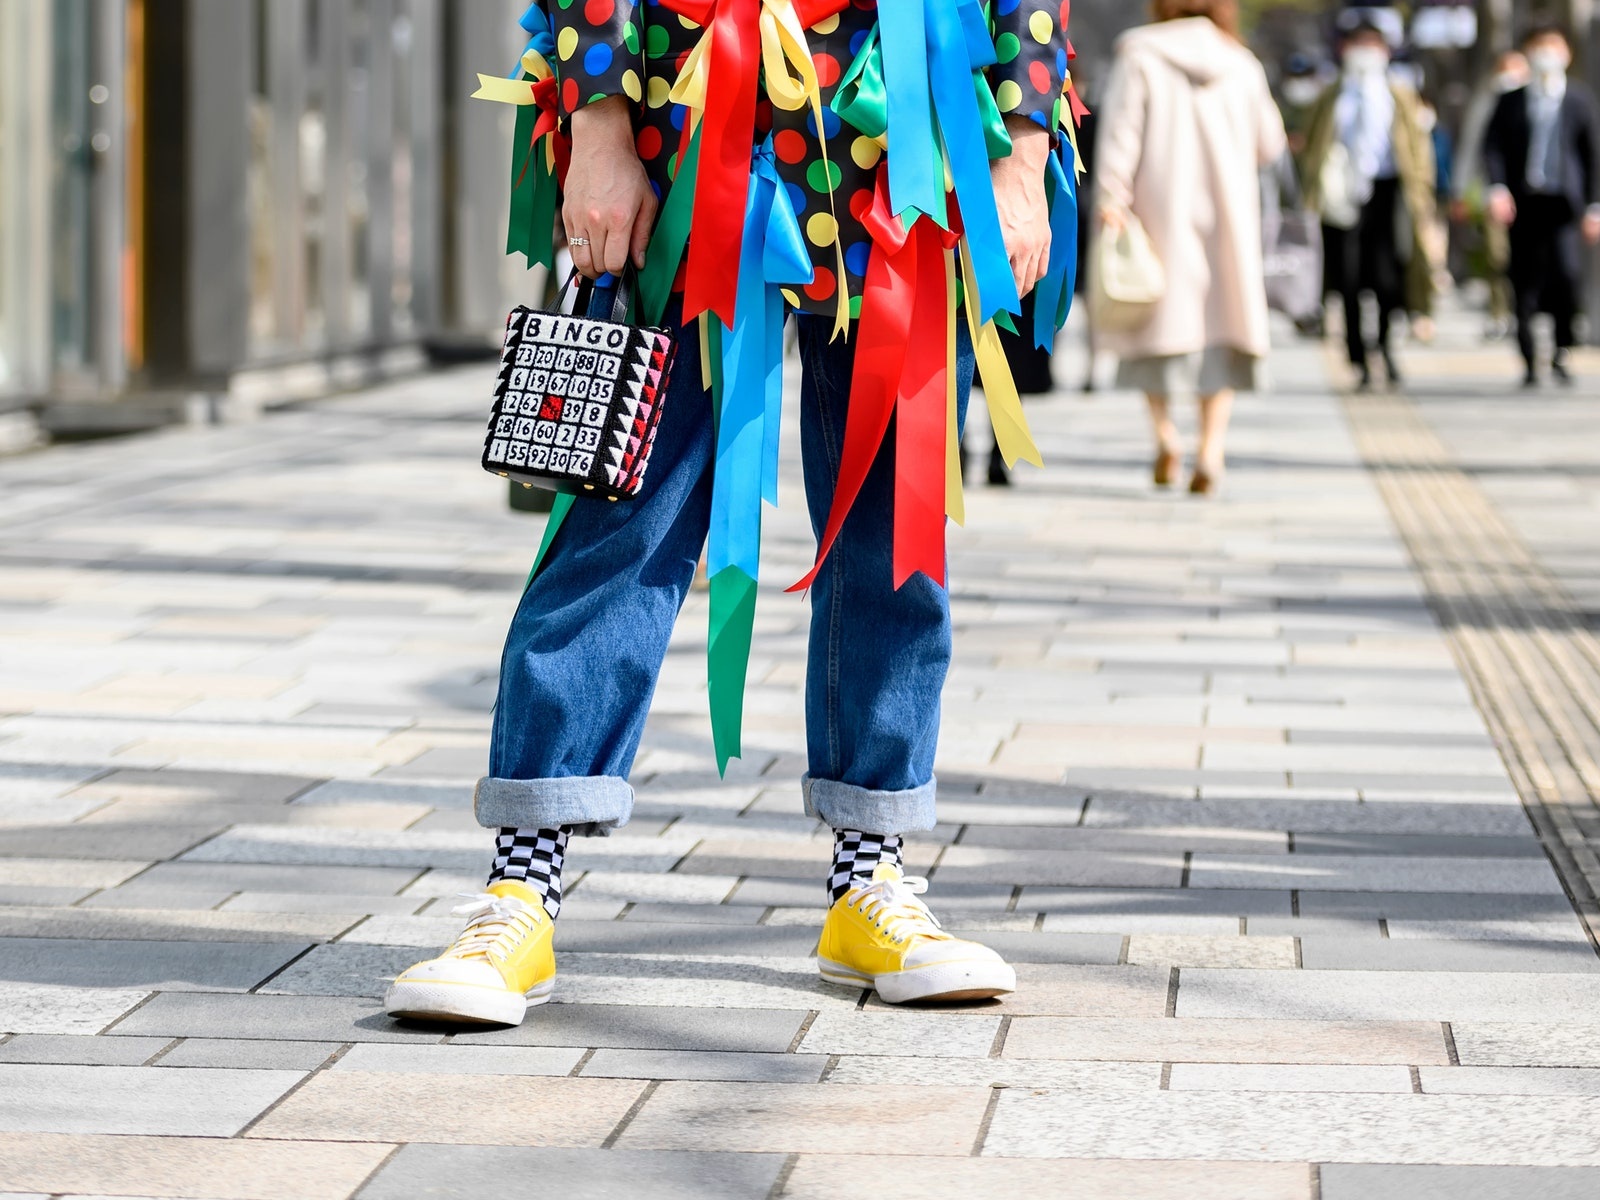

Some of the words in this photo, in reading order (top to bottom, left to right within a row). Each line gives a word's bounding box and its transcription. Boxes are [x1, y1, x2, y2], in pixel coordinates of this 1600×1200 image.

[526, 318, 623, 348] BINGO
[518, 348, 532, 362] 73
[537, 351, 552, 364] 20
[558, 354, 571, 367] 16
[577, 355, 594, 370] 88
[599, 358, 614, 374] 12
[514, 372, 521, 386] 6
[532, 375, 545, 388] 19
[550, 376, 566, 391] 67
[570, 379, 585, 394] 10
[591, 382, 610, 398] 35
[504, 395, 517, 408] 12
[523, 399, 538, 412] 62
[565, 403, 581, 418] 39
[589, 407, 599, 421] 8
[499, 419, 512, 432] 28
[517, 421, 530, 435] 16
[537, 425, 553, 439] 60
[563, 429, 570, 442] 2
[578, 431, 596, 446] 33
[510, 445, 526, 459] 55
[532, 449, 546, 464] 92
[551, 452, 567, 467] 30
[572, 454, 589, 471] 76
